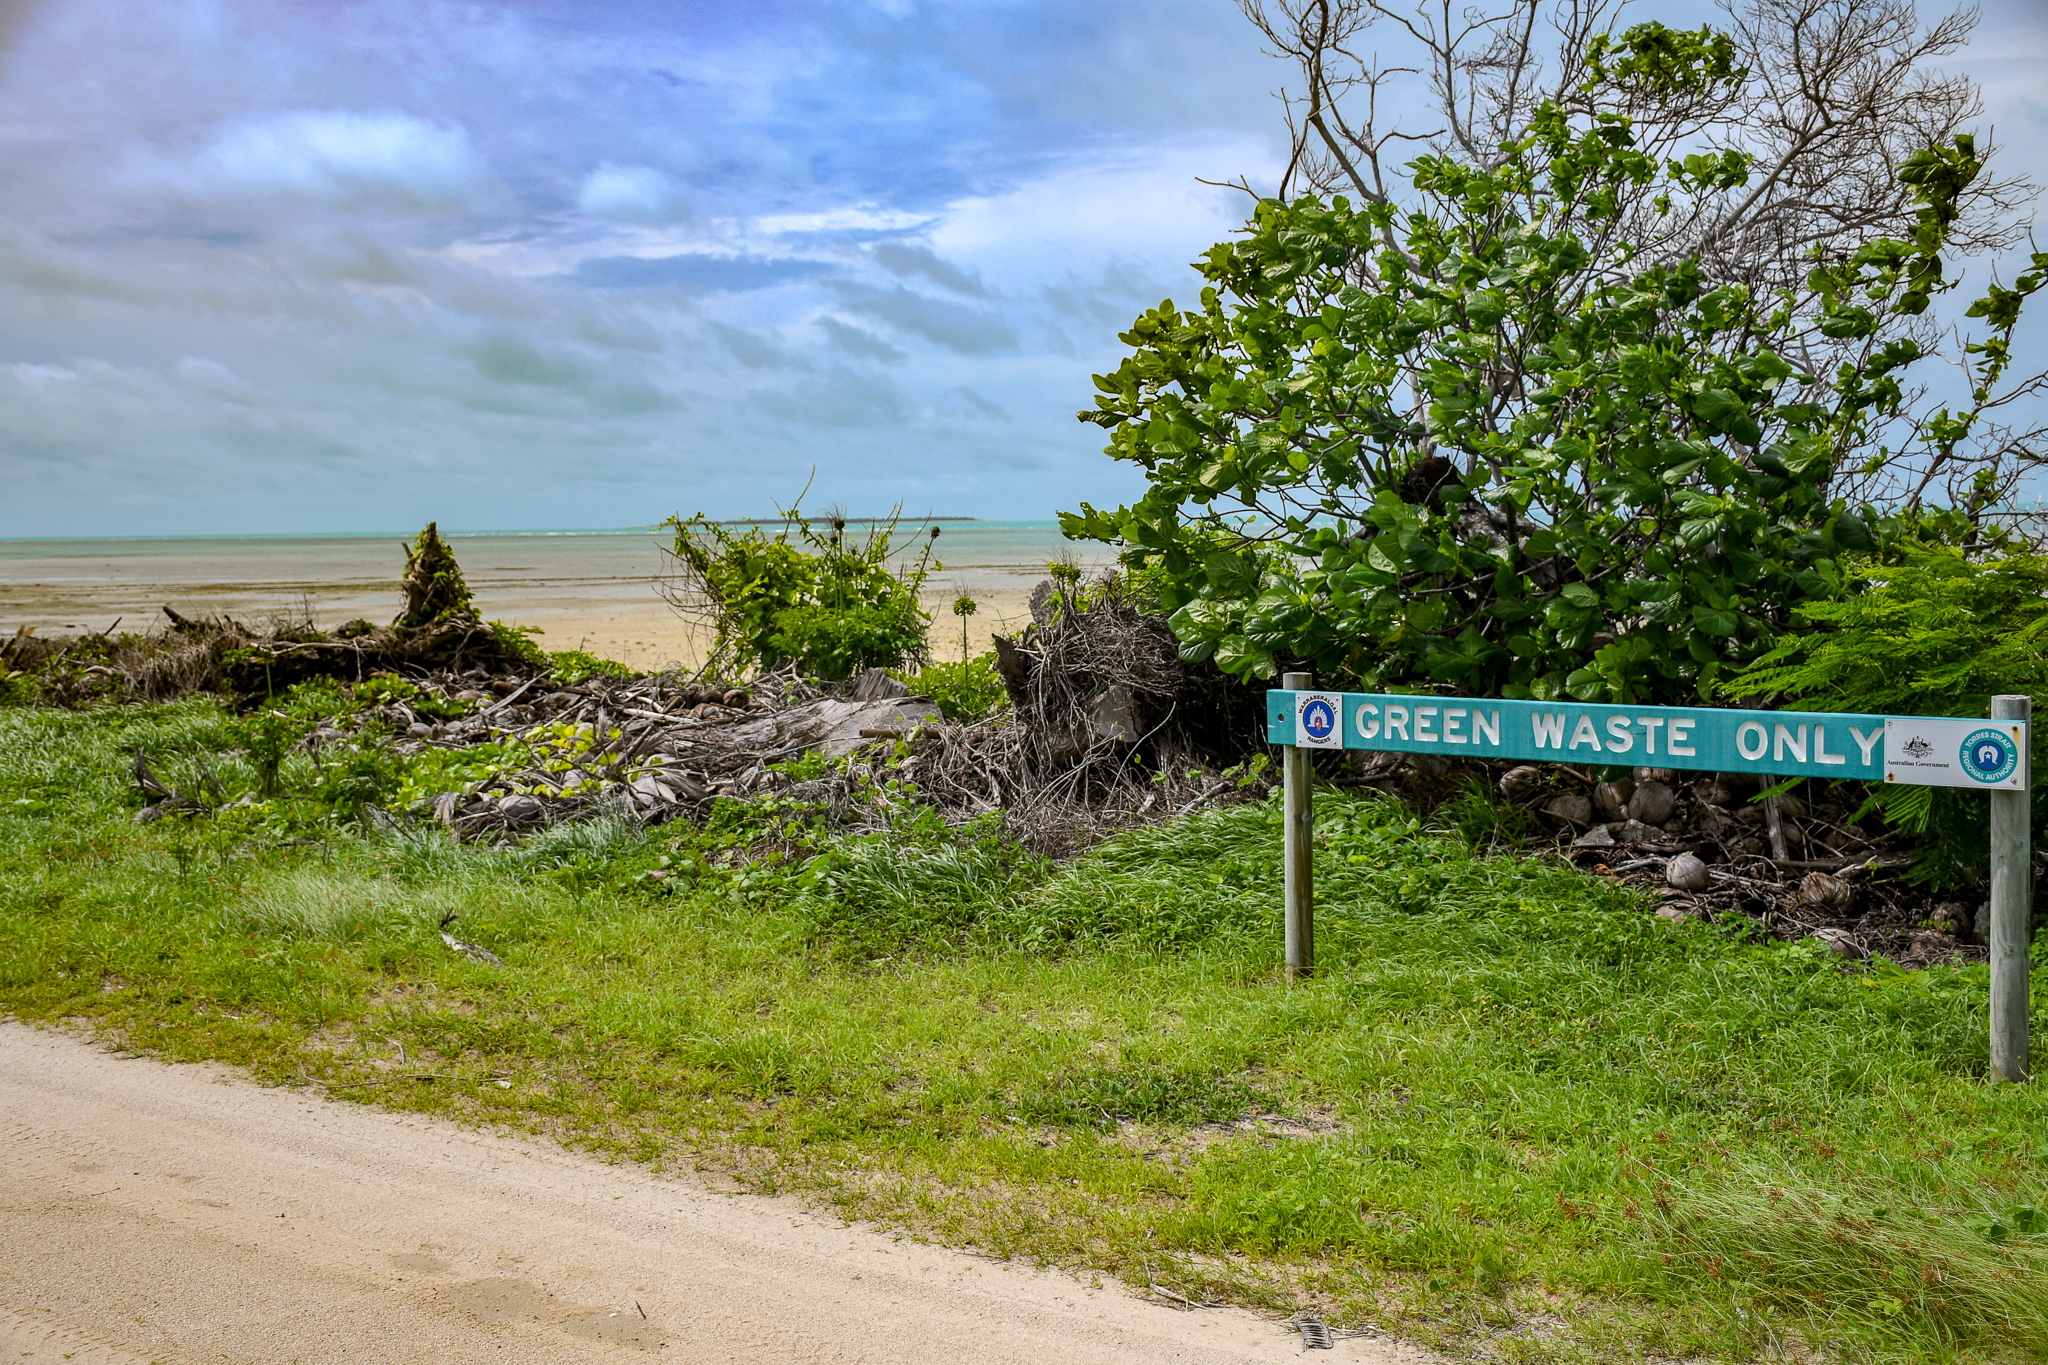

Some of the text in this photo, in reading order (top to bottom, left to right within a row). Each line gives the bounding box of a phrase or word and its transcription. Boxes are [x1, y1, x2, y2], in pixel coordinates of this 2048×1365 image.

[1307, 735, 1332, 745] RANGERS
[1355, 703, 1885, 766] GREEN WASTE ONLY
[1965, 731, 2012, 749] TORRES STRAIT
[1962, 750, 2014, 781] REGIONAL AUTHORITY
